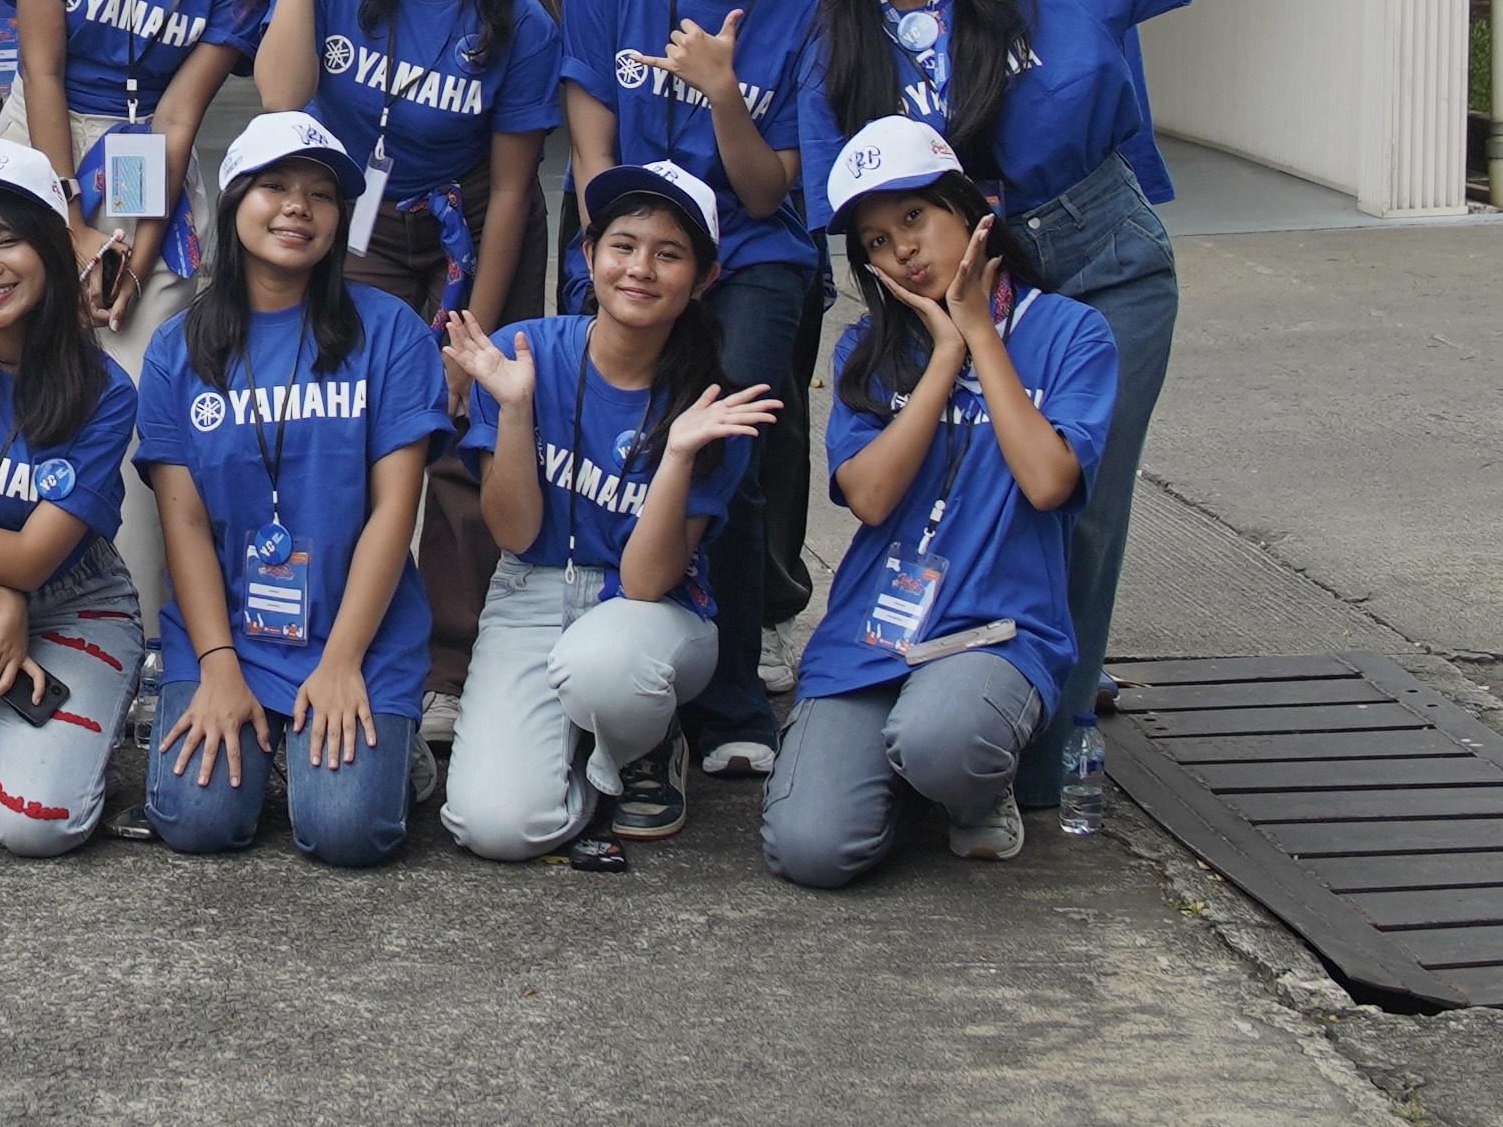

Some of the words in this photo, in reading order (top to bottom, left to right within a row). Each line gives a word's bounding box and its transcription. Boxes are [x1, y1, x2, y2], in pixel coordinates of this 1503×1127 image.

[354, 47, 483, 115] YAMAHA
[651, 66, 776, 120] YAMHA
[229, 379, 367, 426] YAMAHA
[544, 442, 648, 518] YAMAH
